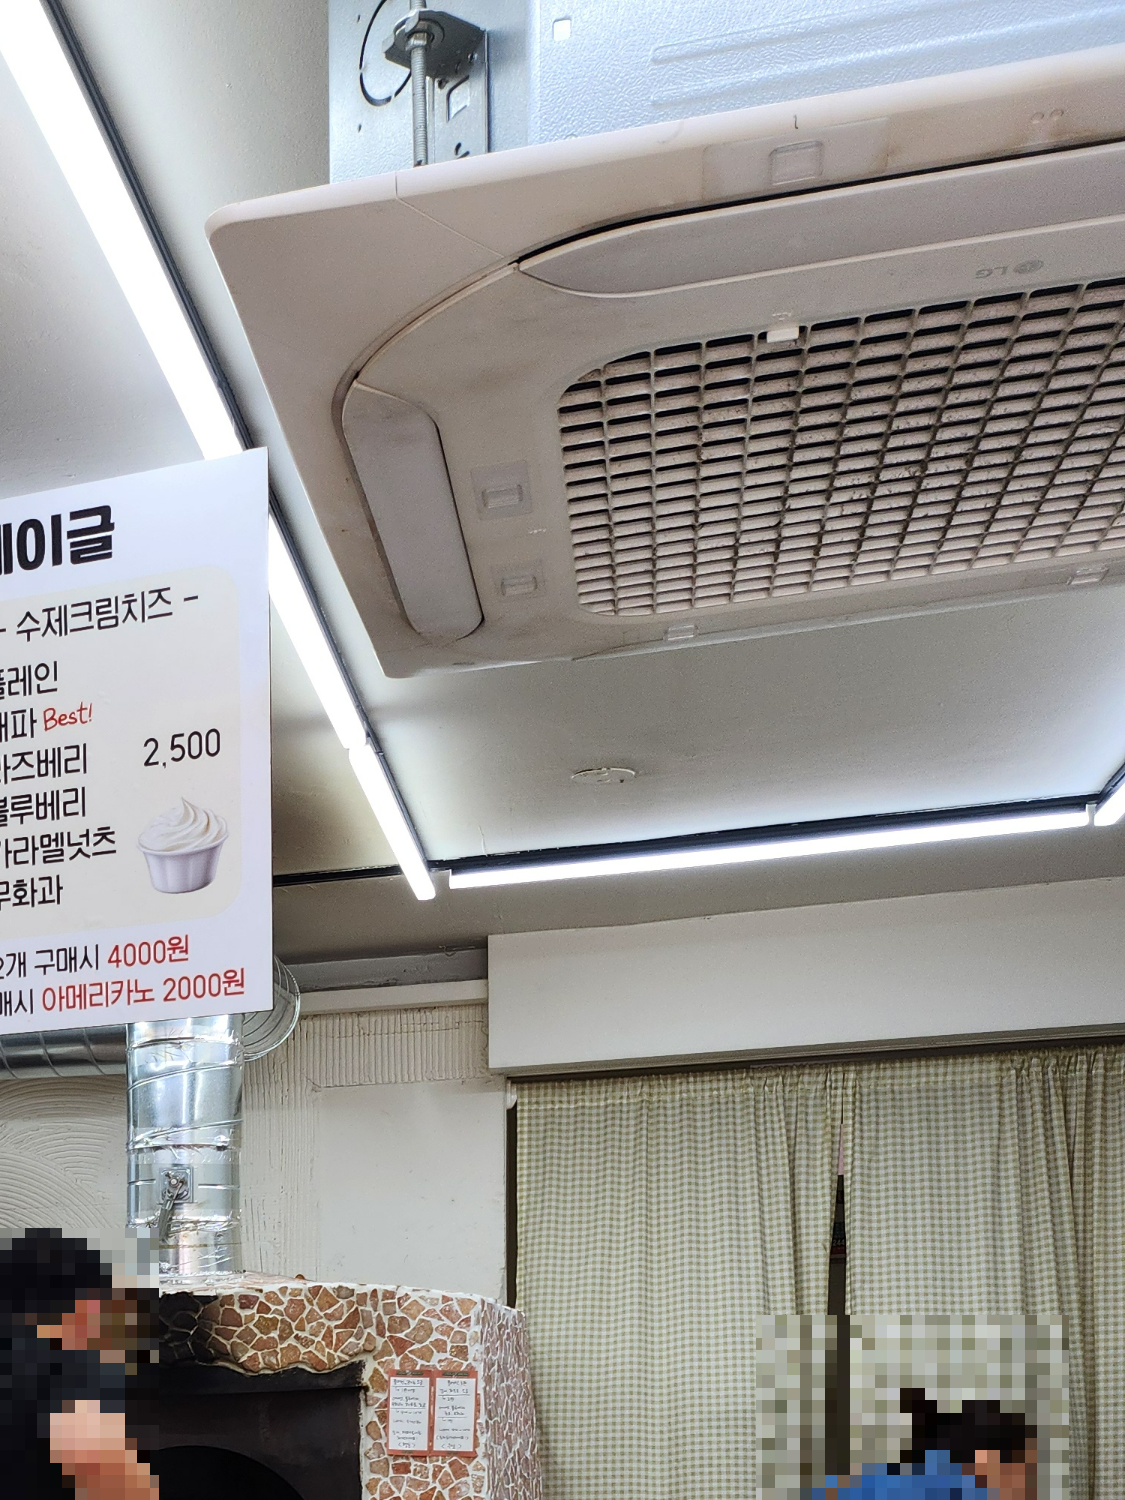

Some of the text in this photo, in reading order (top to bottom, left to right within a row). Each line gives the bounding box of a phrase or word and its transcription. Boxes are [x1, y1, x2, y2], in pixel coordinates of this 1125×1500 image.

[973, 265, 1009, 280] LG
[17, 587, 172, 641] 수제크림치즈
[44, 703, 91, 731] Best!
[144, 729, 220, 766] 2,500
[35, 944, 98, 975] 구매시
[108, 935, 188, 967] 4000원
[43, 980, 154, 1011] 아메리카노
[164, 968, 244, 1001] 2000원
